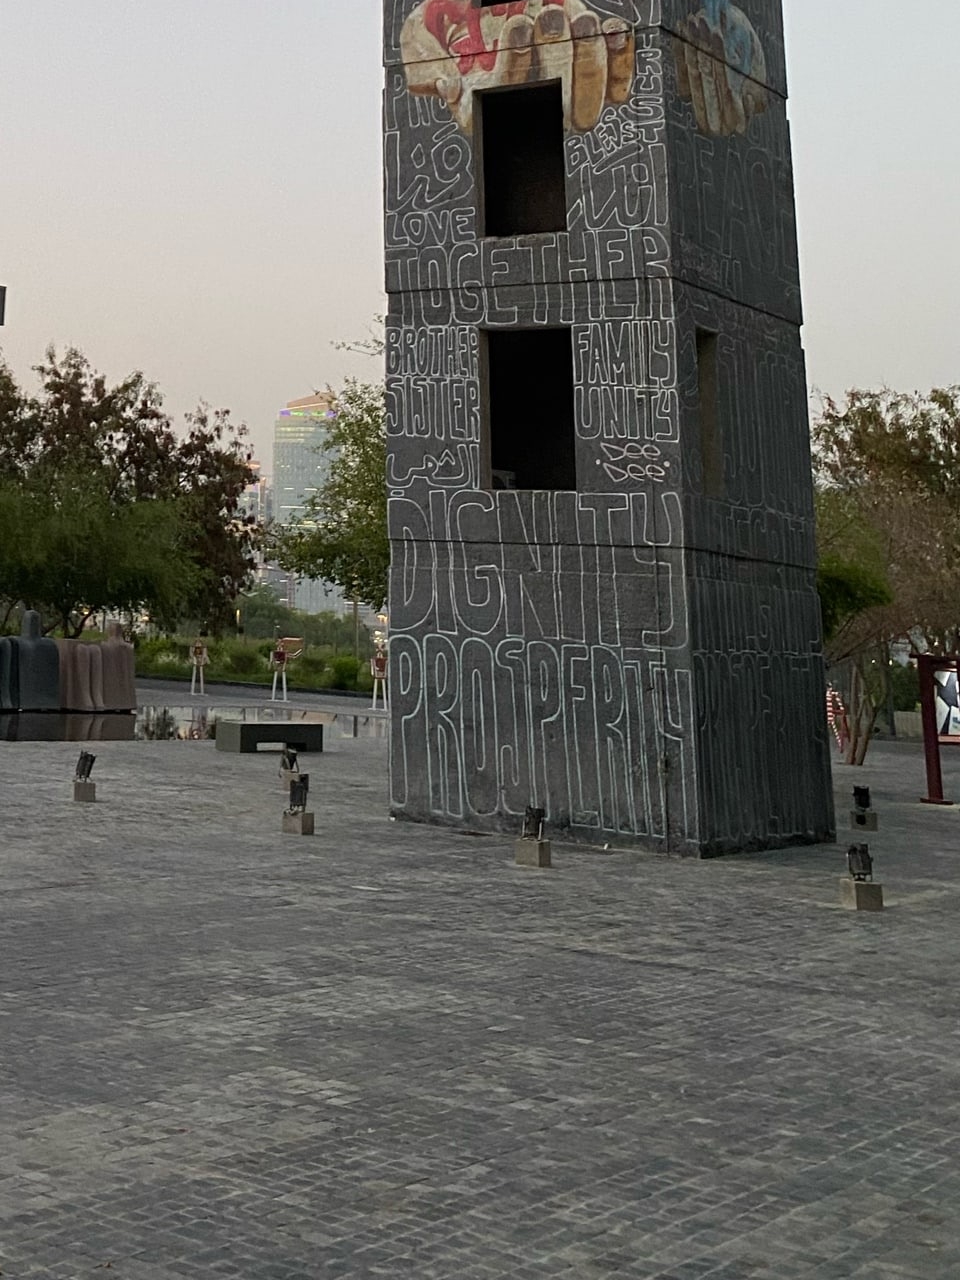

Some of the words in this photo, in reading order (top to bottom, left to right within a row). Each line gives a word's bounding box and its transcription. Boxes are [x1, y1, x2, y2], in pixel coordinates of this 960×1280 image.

[628, 32, 666, 144] TRUST
[565, 106, 640, 177] BLESS
[386, 206, 475, 247] LOVE
[386, 227, 676, 327] TOGETHER
[386, 326, 481, 378] BROTHER
[572, 320, 677, 389] FAMILY
[386, 376, 481, 442] SISTER
[574, 385, 681, 443] UNITY
[388, 488, 689, 652] DIGNITY
[389, 634, 700, 844] PROSPERITY
